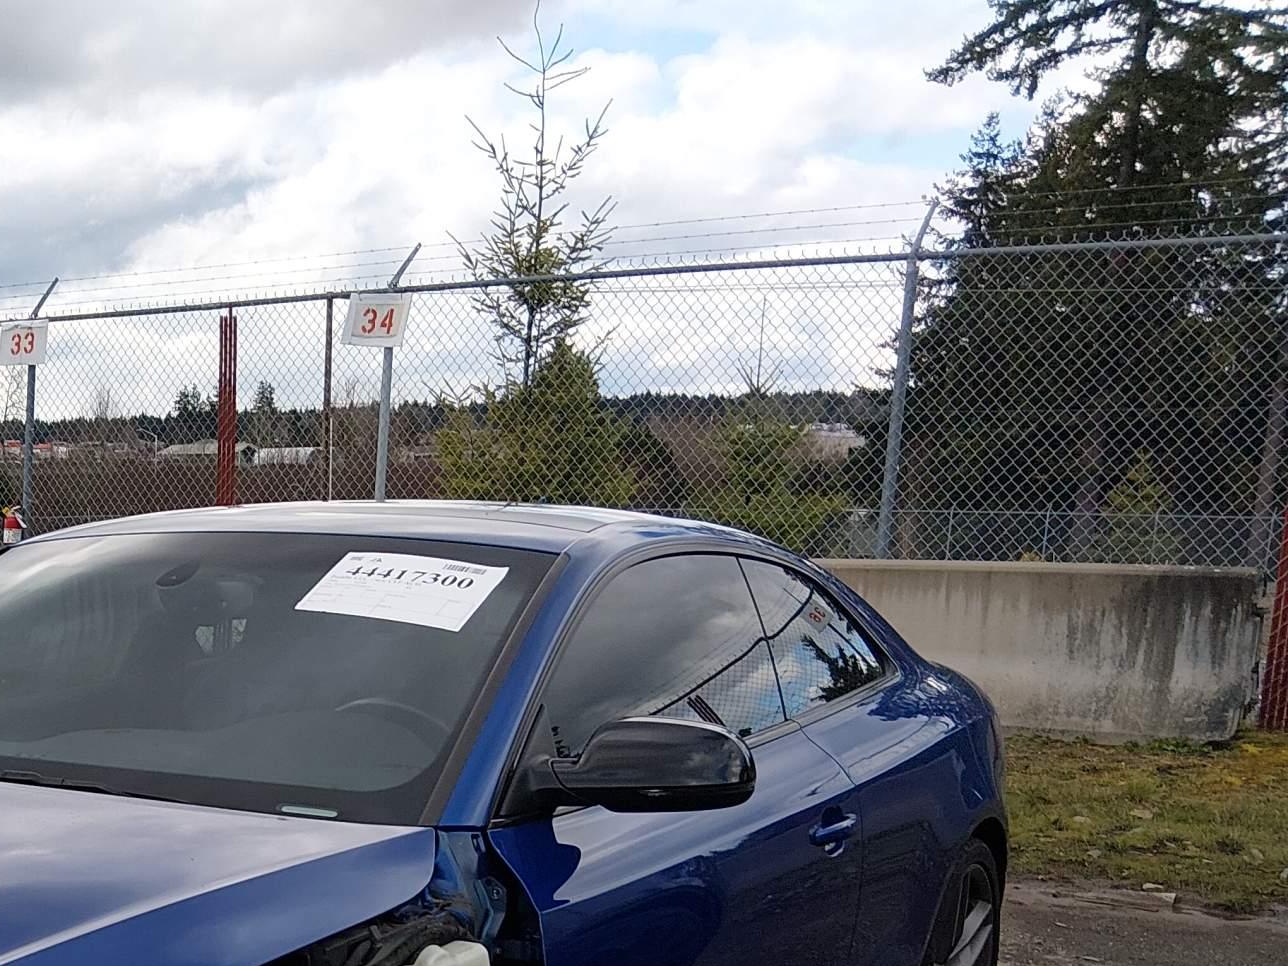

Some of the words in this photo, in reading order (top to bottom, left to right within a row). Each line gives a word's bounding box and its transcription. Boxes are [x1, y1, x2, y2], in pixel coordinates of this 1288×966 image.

[361, 306, 395, 335] 34
[10, 332, 35, 356] 33
[345, 564, 476, 590] 44417300
